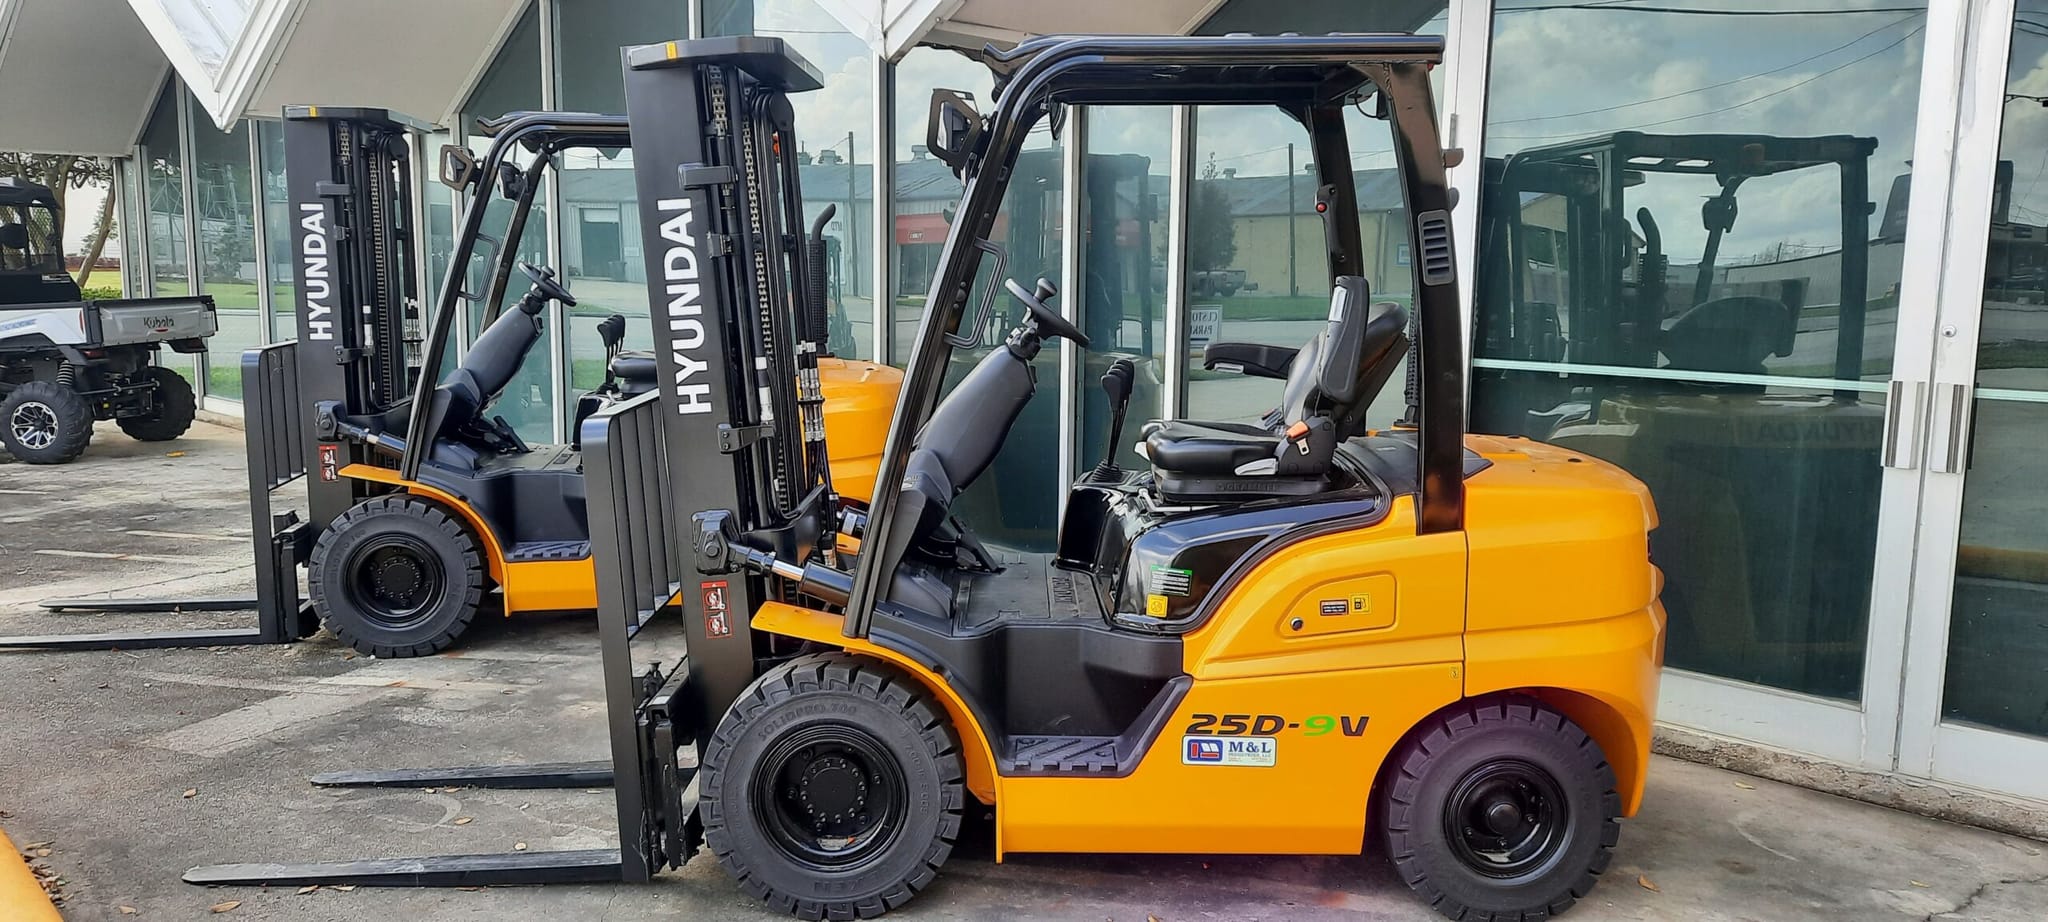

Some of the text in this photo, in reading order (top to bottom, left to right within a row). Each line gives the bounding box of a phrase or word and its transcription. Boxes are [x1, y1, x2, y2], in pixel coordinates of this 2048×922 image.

[300, 203, 333, 340] HYUNDAI
[659, 198, 712, 414] HYUNDAI
[143, 315, 175, 328] Kubota
[1185, 713, 1370, 737] 25D-9V
